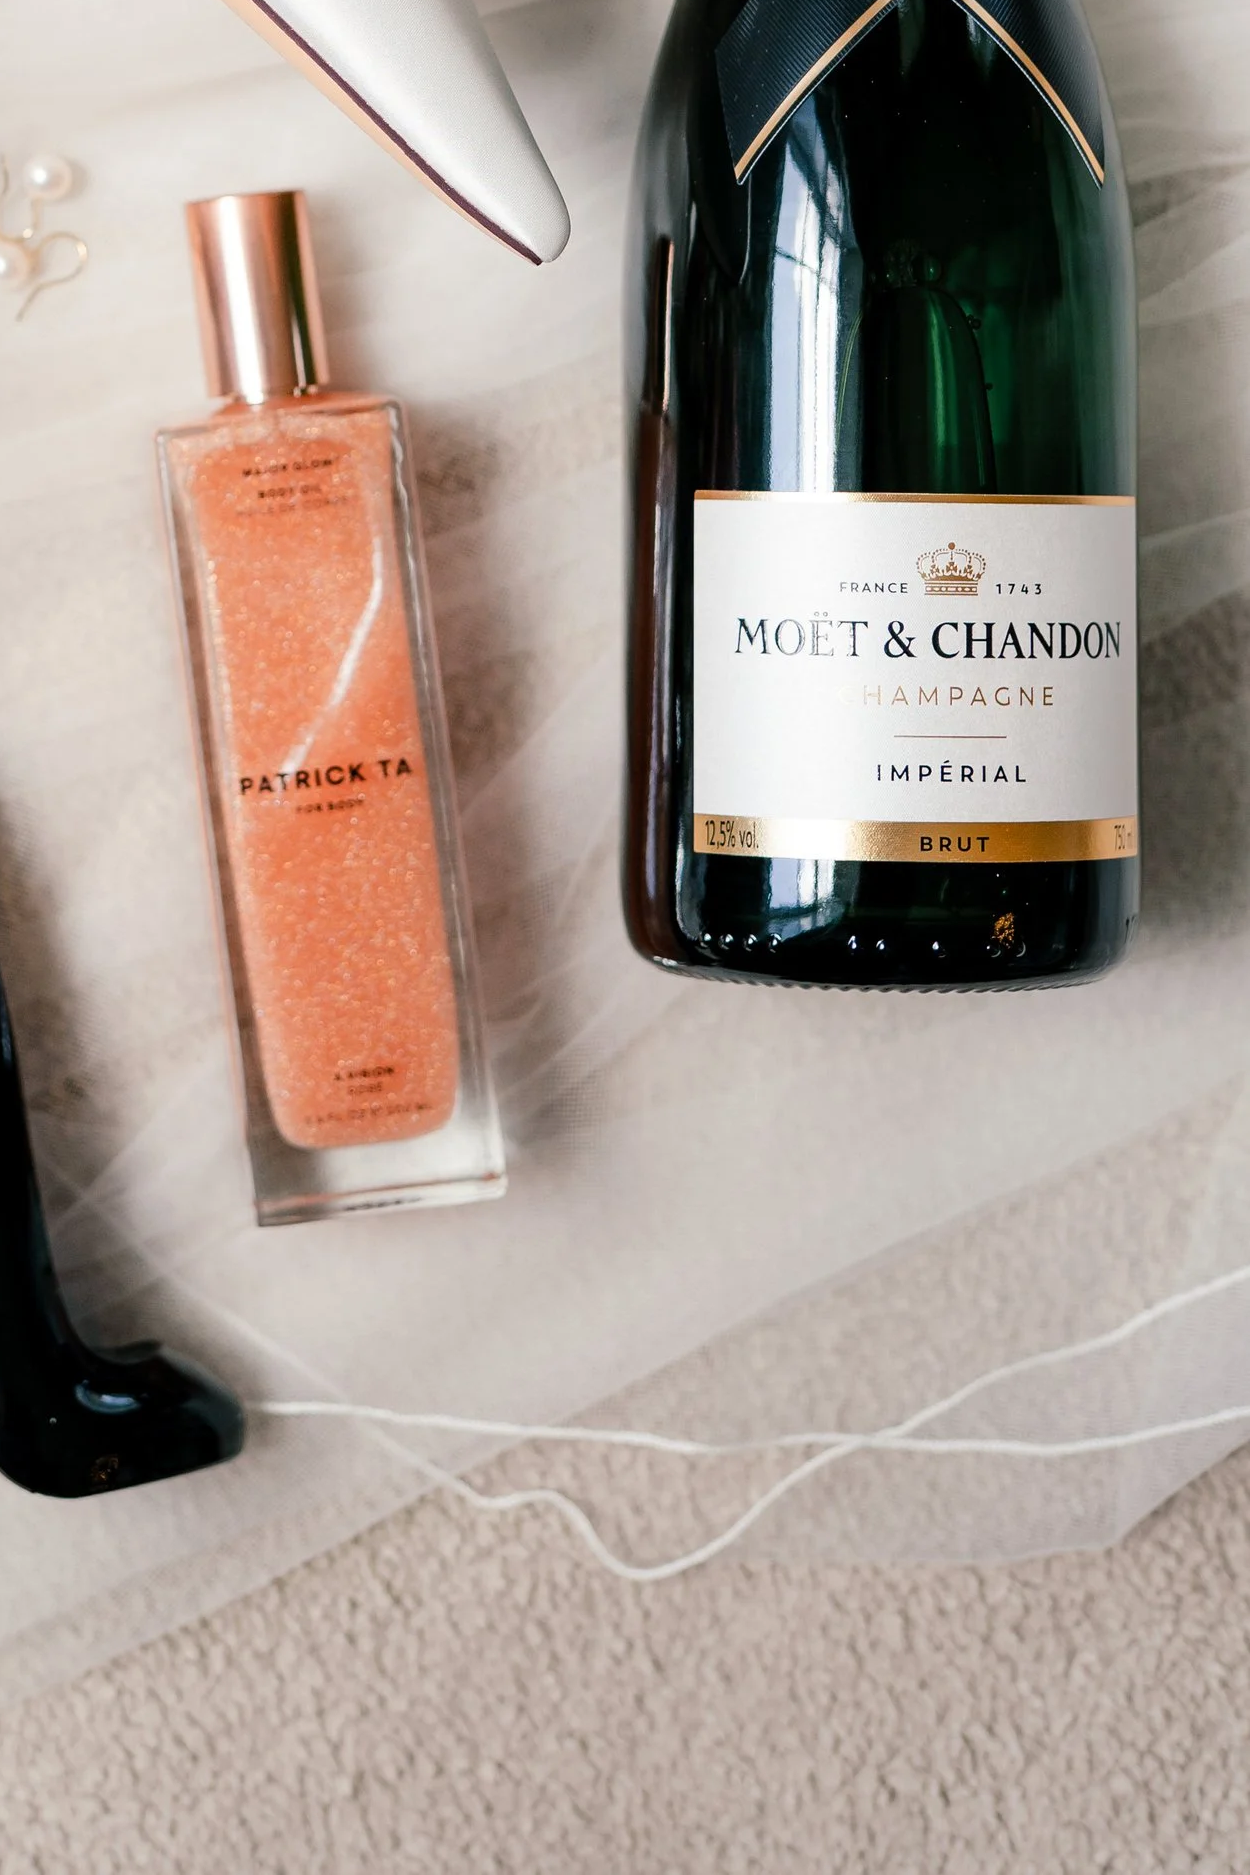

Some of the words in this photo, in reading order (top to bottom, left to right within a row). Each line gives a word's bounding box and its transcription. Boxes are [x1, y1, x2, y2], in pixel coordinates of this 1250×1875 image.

[839, 582, 909, 594] FRANCE
[995, 583, 1043, 595] 1743
[734, 611, 869, 657] MOËT
[882, 620, 918, 659] &
[930, 621, 1121, 659] CHANDON
[239, 761, 366, 796] PATRICK
[377, 757, 412, 779] TA
[876, 759, 1027, 783] IMPÉRIAL
[705, 819, 736, 849] 12,5%
[738, 821, 759, 849] vol.
[919, 836, 990, 852] BRUT
